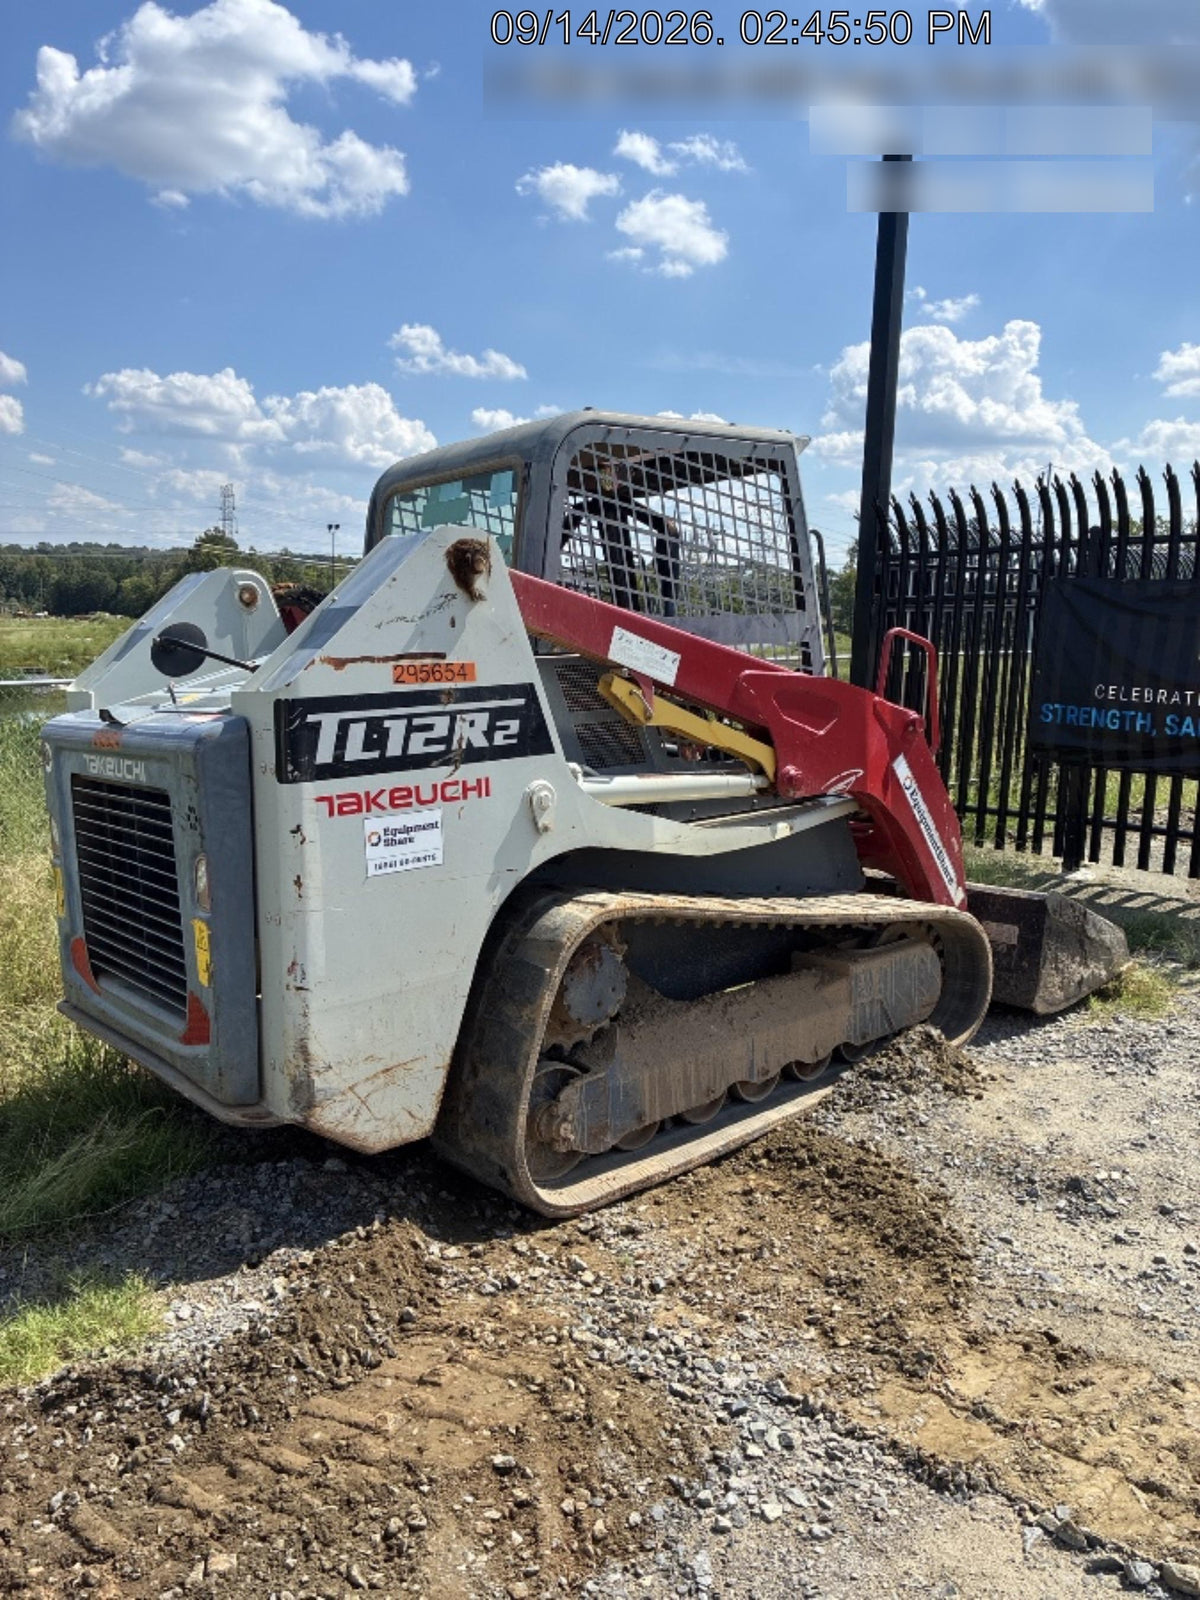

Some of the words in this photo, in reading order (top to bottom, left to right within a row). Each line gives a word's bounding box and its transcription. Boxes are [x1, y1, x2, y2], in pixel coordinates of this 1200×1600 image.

[393, 664, 469, 683] 295654
[1040, 702, 1157, 737] STRENGTH,
[1164, 713, 1200, 738] SA
[383, 820, 440, 838] Equipment
[383, 836, 415, 847] Share
